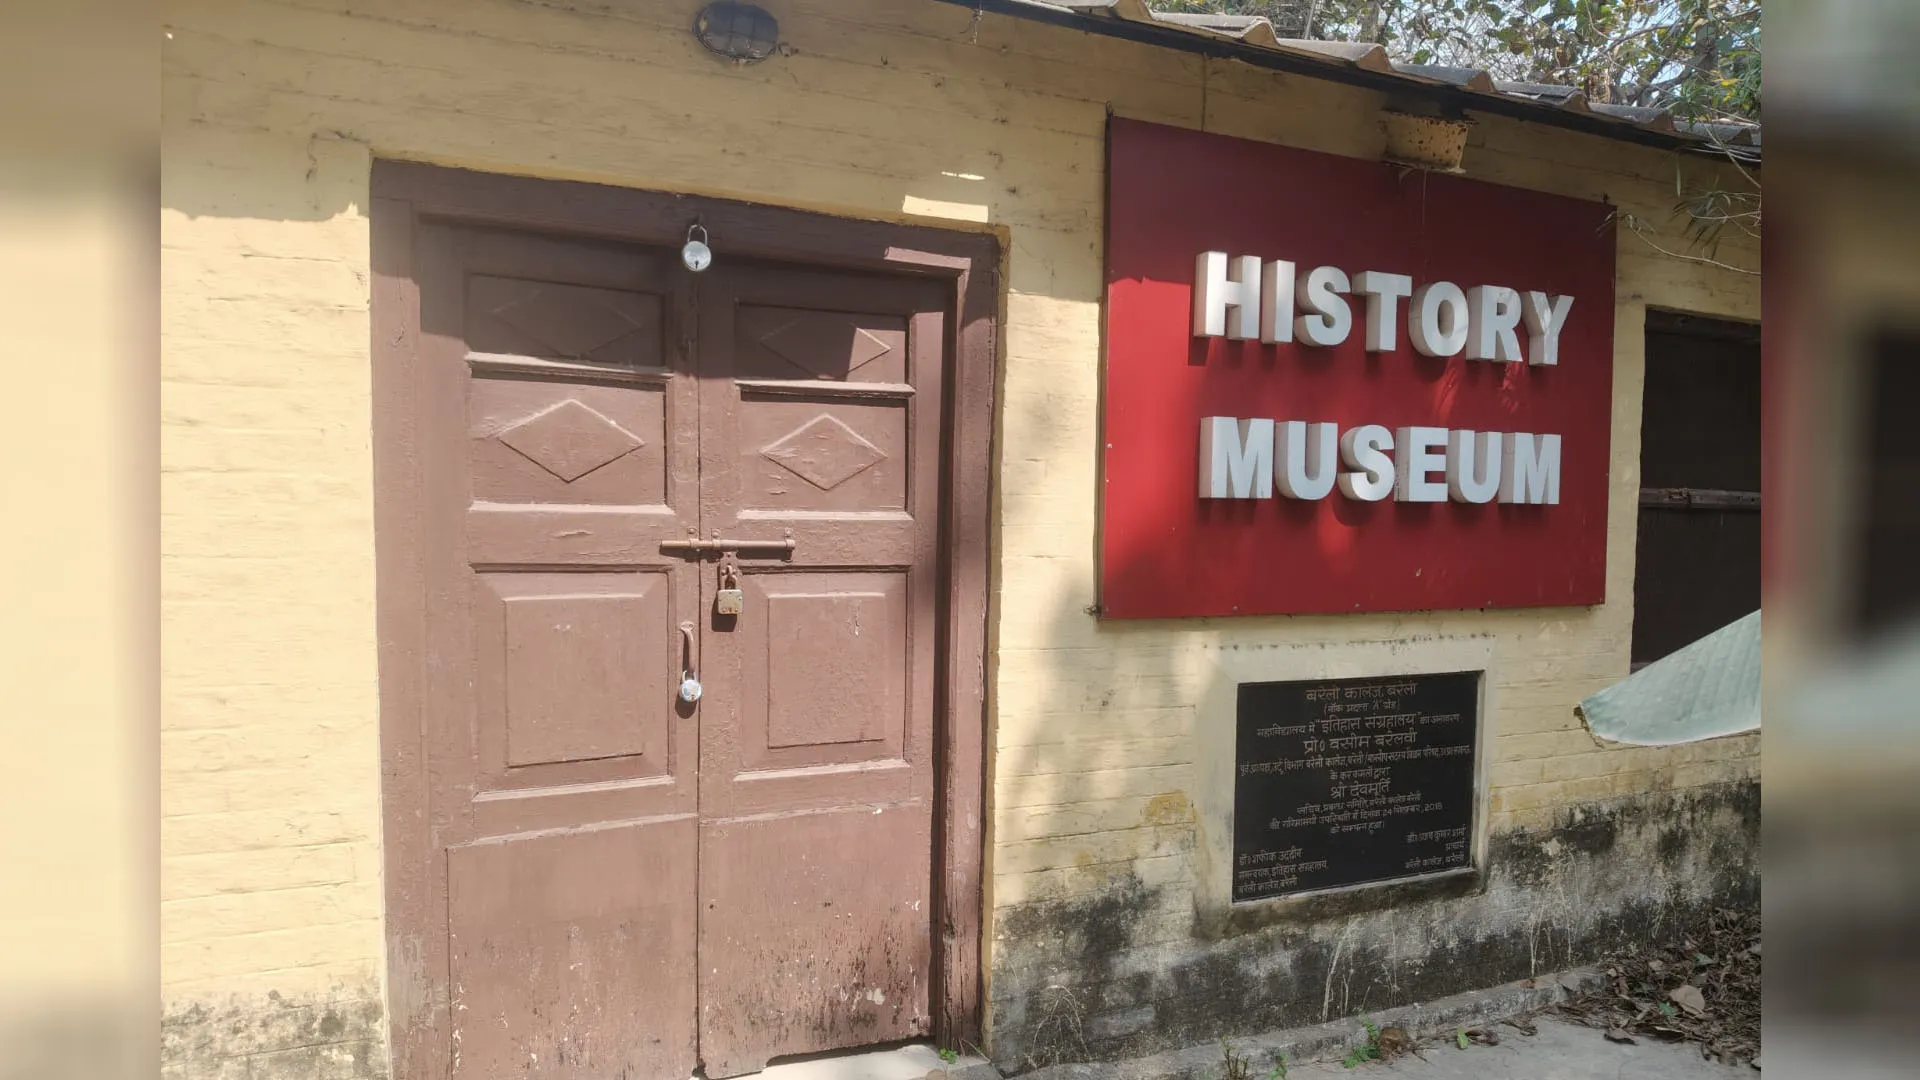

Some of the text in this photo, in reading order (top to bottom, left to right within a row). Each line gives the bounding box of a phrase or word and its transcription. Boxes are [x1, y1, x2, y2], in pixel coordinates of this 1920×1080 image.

[1193, 250, 1575, 365] HISTORY
[1199, 416, 1562, 504] MUSEUM
[1305, 685, 1340, 702] बरेली
[1385, 681, 1418, 696] बरेली
[1308, 721, 1316, 734] में
[1329, 732, 1371, 750] वसीम
[1374, 727, 1417, 746] बरेलवी
[1330, 777, 1391, 799] श्री देवमूर्ति
